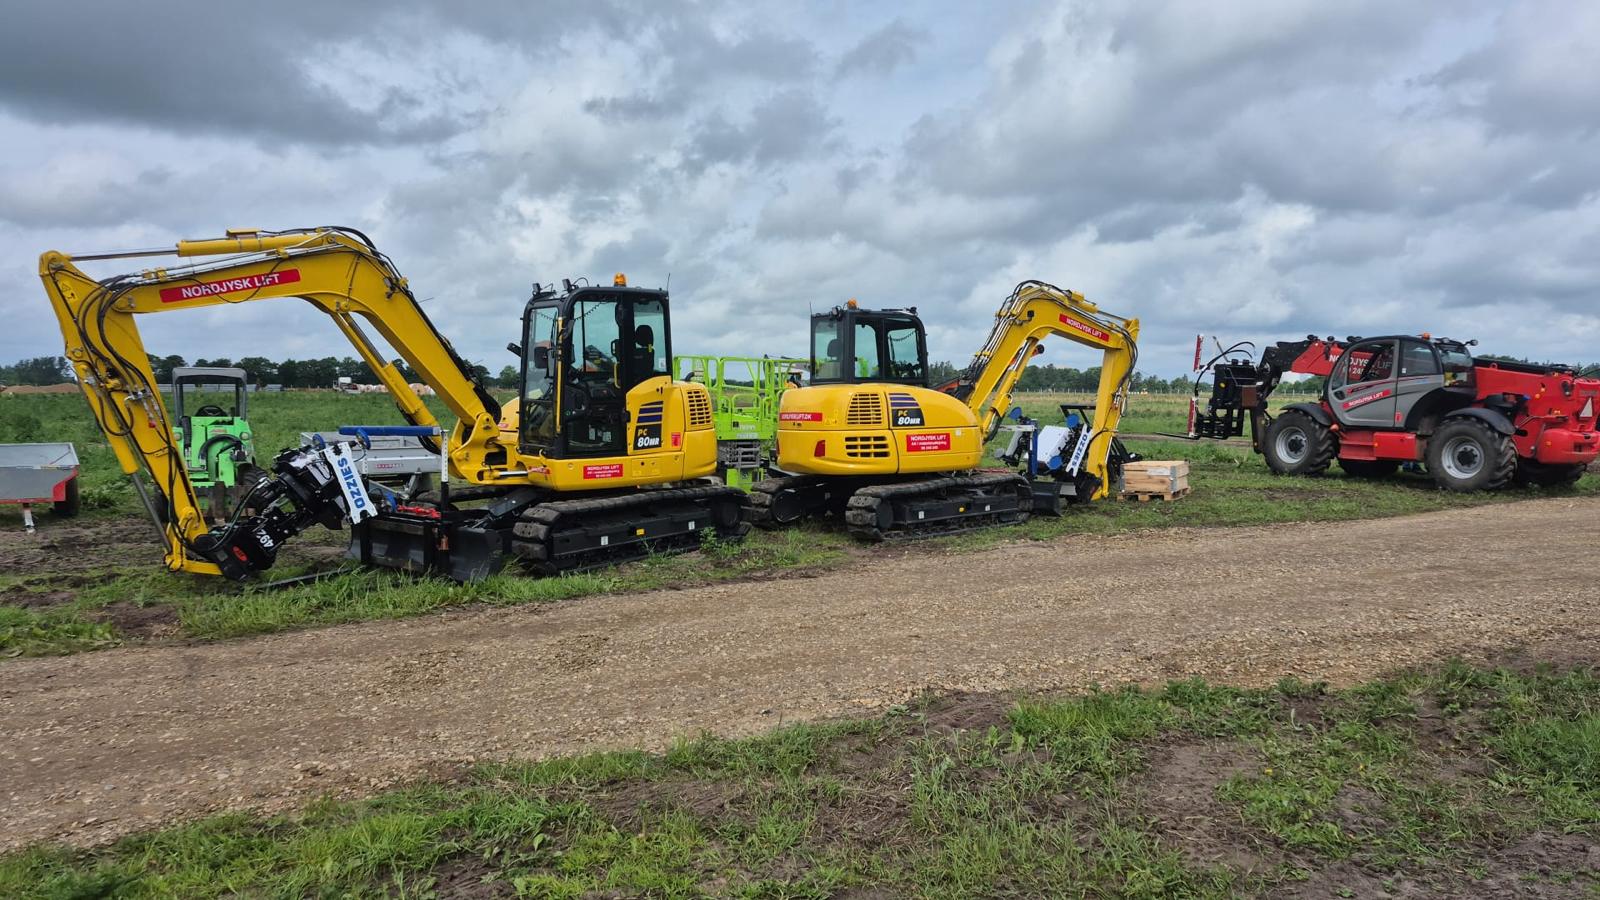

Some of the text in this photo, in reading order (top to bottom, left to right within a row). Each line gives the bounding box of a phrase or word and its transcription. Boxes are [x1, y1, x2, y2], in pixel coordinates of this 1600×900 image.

[181, 273, 280, 298] NORDJYSK LIFT
[897, 416, 921, 425] 80MR
[637, 428, 648, 437] PC
[637, 436, 660, 448] 80MR
[337, 457, 366, 509] OZZIES
